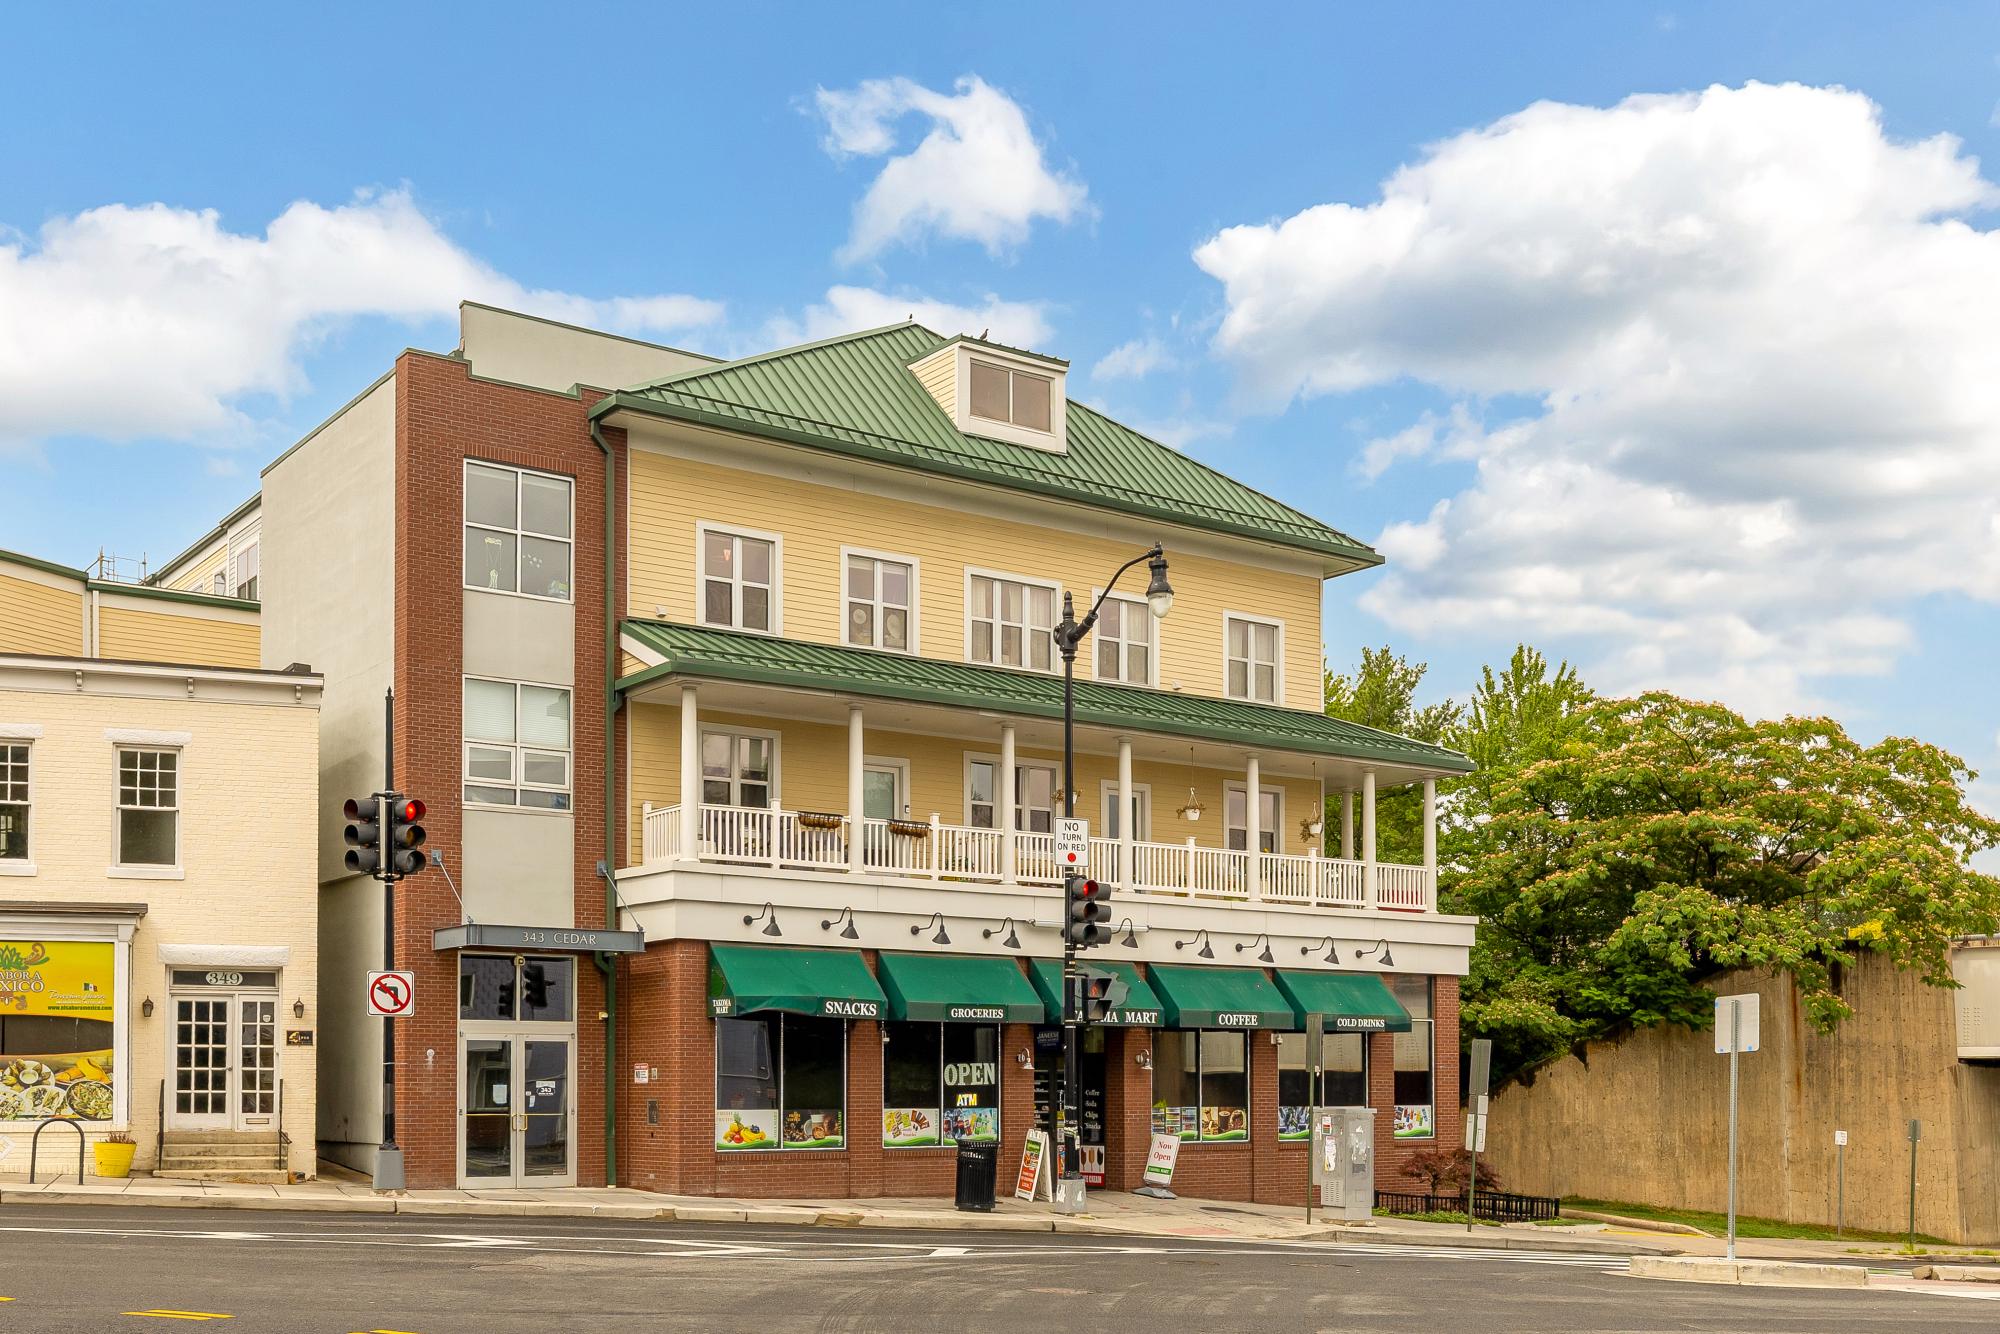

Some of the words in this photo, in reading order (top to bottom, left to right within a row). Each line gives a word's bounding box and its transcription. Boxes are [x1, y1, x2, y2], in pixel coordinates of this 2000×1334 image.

[1064, 822, 1079, 831] NO
[1062, 833, 1082, 841] TURN
[1057, 842, 1068, 850] ON
[1071, 843, 1086, 851] RED
[522, 931, 545, 943] 343
[553, 932, 597, 945] CEDAR
[32, 970, 43, 980] A
[209, 972, 240, 985] 349
[825, 1000, 877, 1016] SNACKS
[951, 1007, 1004, 1019] GROCERIES
[1125, 1011, 1158, 1024] MART
[1218, 1013, 1258, 1026] COFFEE
[1337, 1018, 1357, 1027] COLD
[1358, 1019, 1385, 1028] DRINKS
[943, 1062, 996, 1087] OPEN
[956, 1093, 978, 1107] ATM
[1158, 1141, 1173, 1150] Now
[1153, 1151, 1172, 1162] Open
